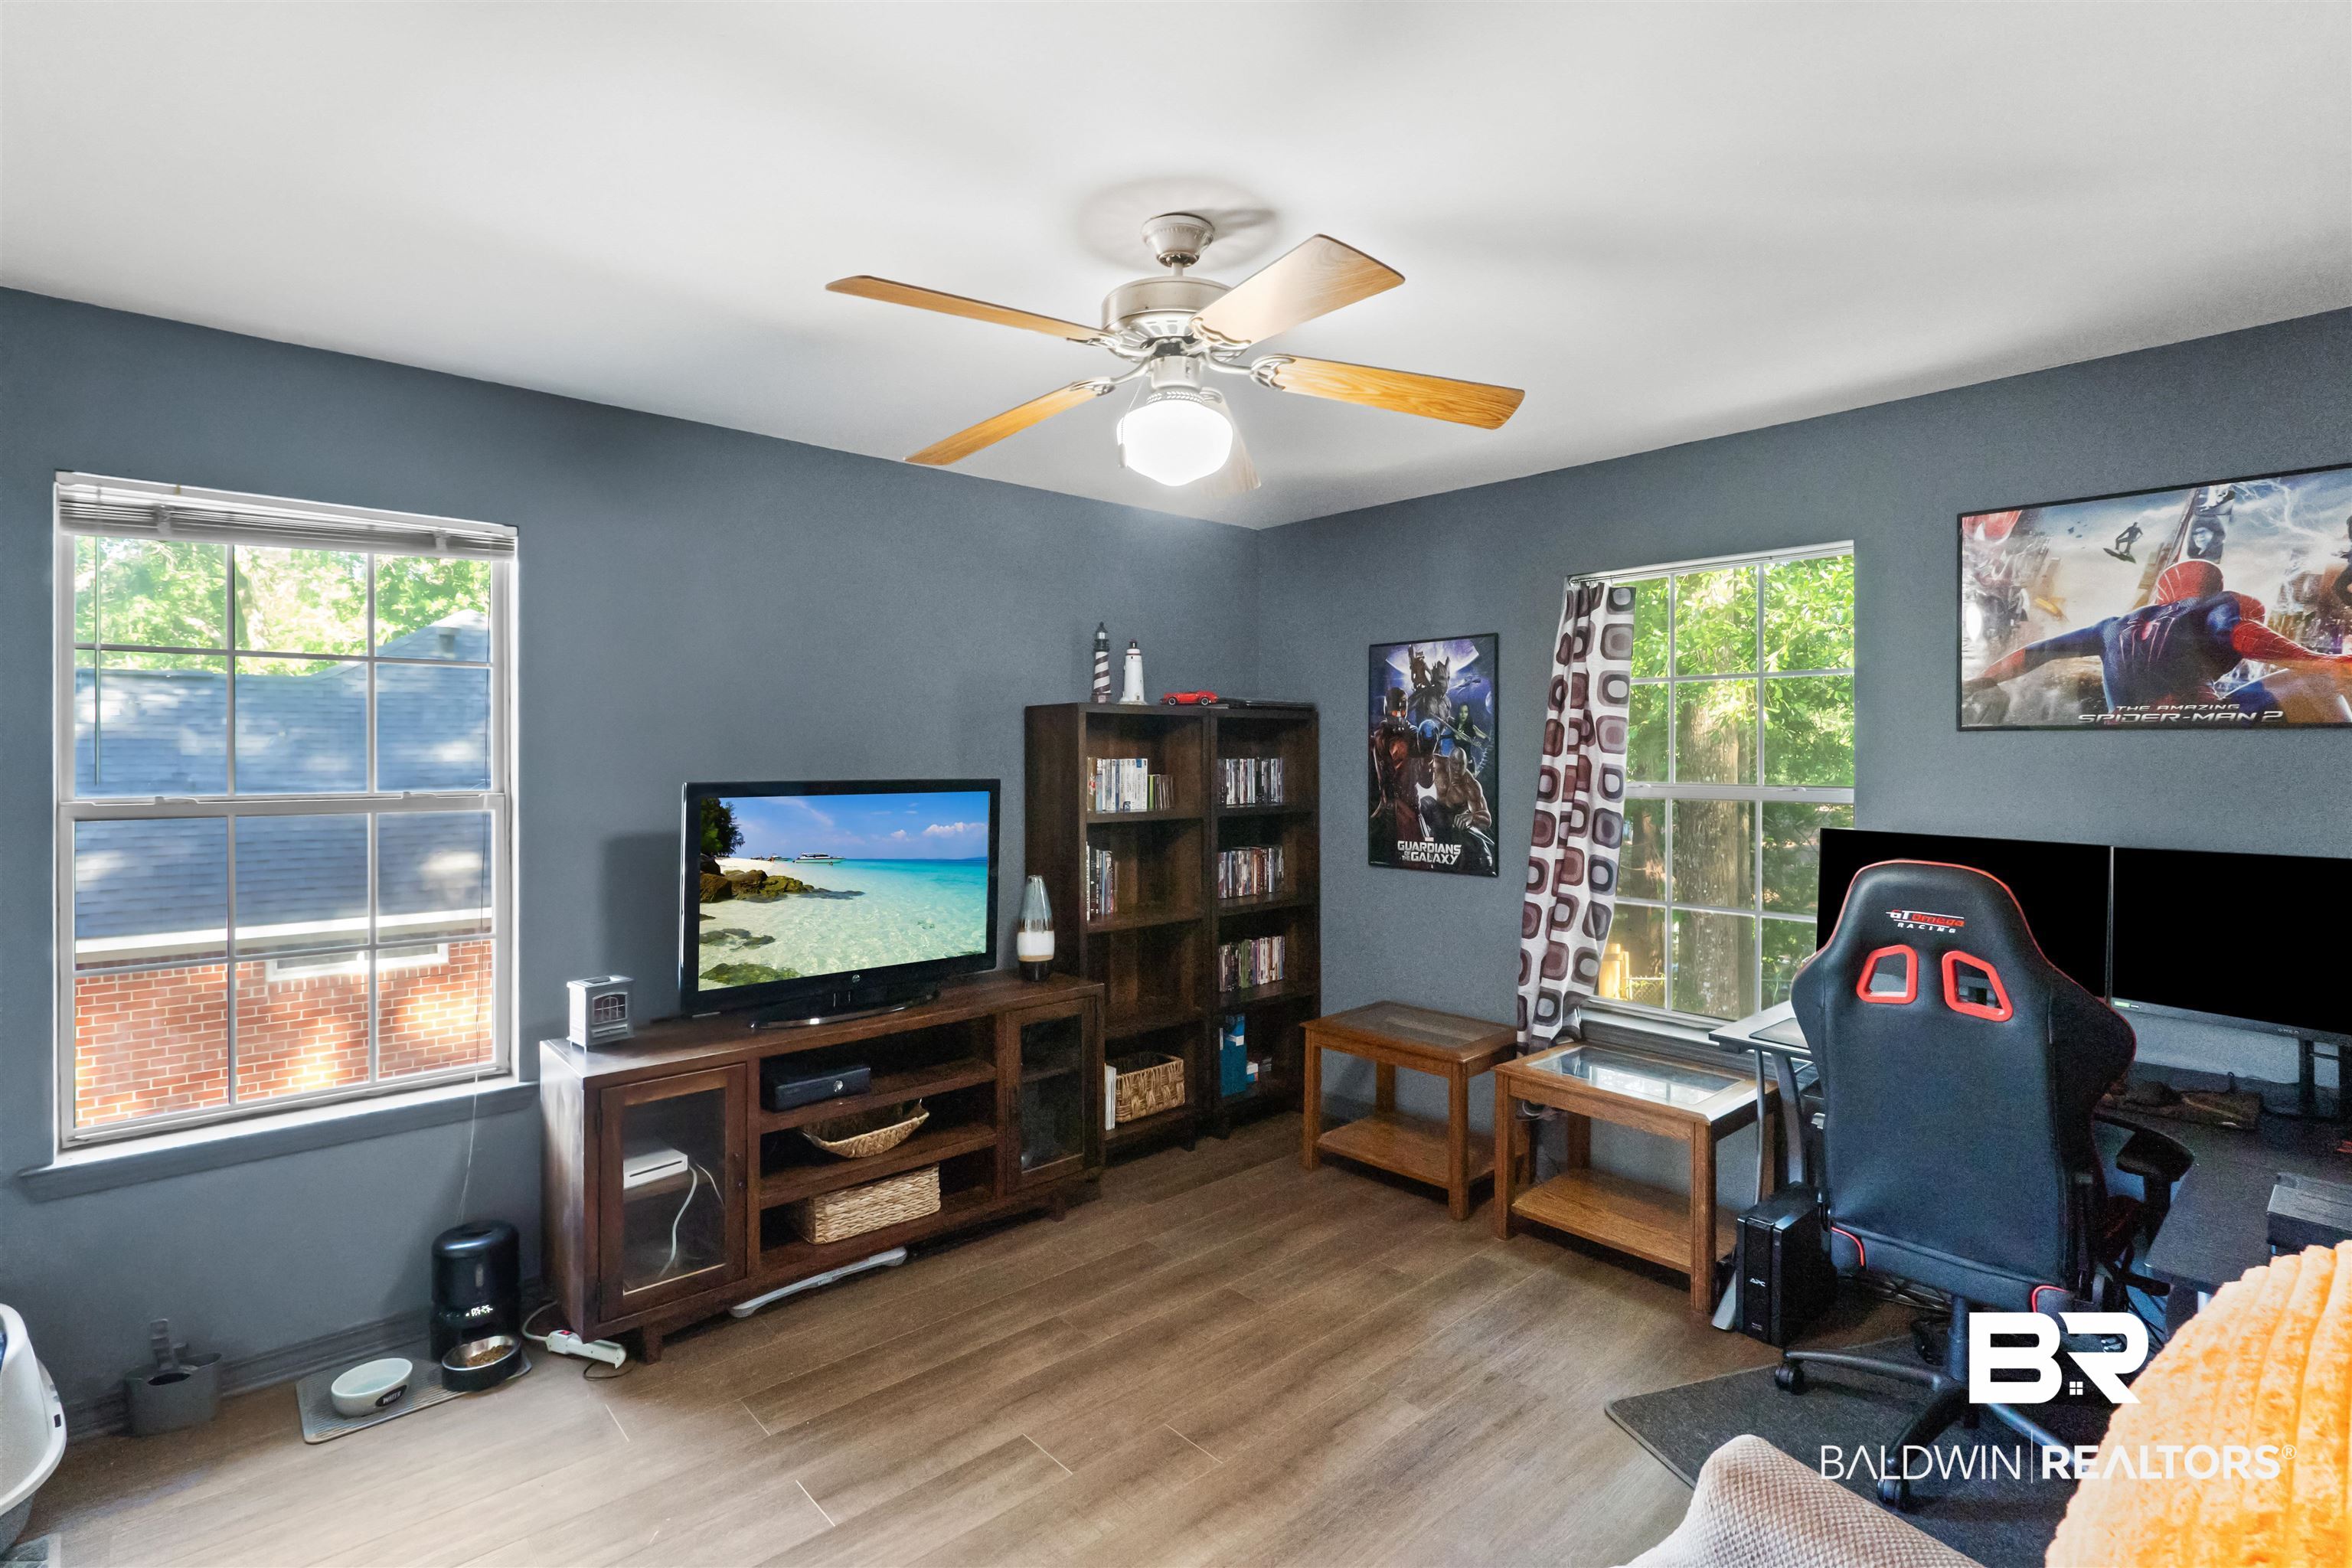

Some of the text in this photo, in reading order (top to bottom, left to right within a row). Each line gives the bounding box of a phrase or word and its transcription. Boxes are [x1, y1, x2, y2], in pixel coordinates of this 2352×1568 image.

[2078, 710, 2284, 724] SPIDER-MAN 2
[1397, 840, 1462, 855] GUARDIANS
[1410, 851, 1459, 865] GALAXY
[1897, 922, 1956, 933] RACING
